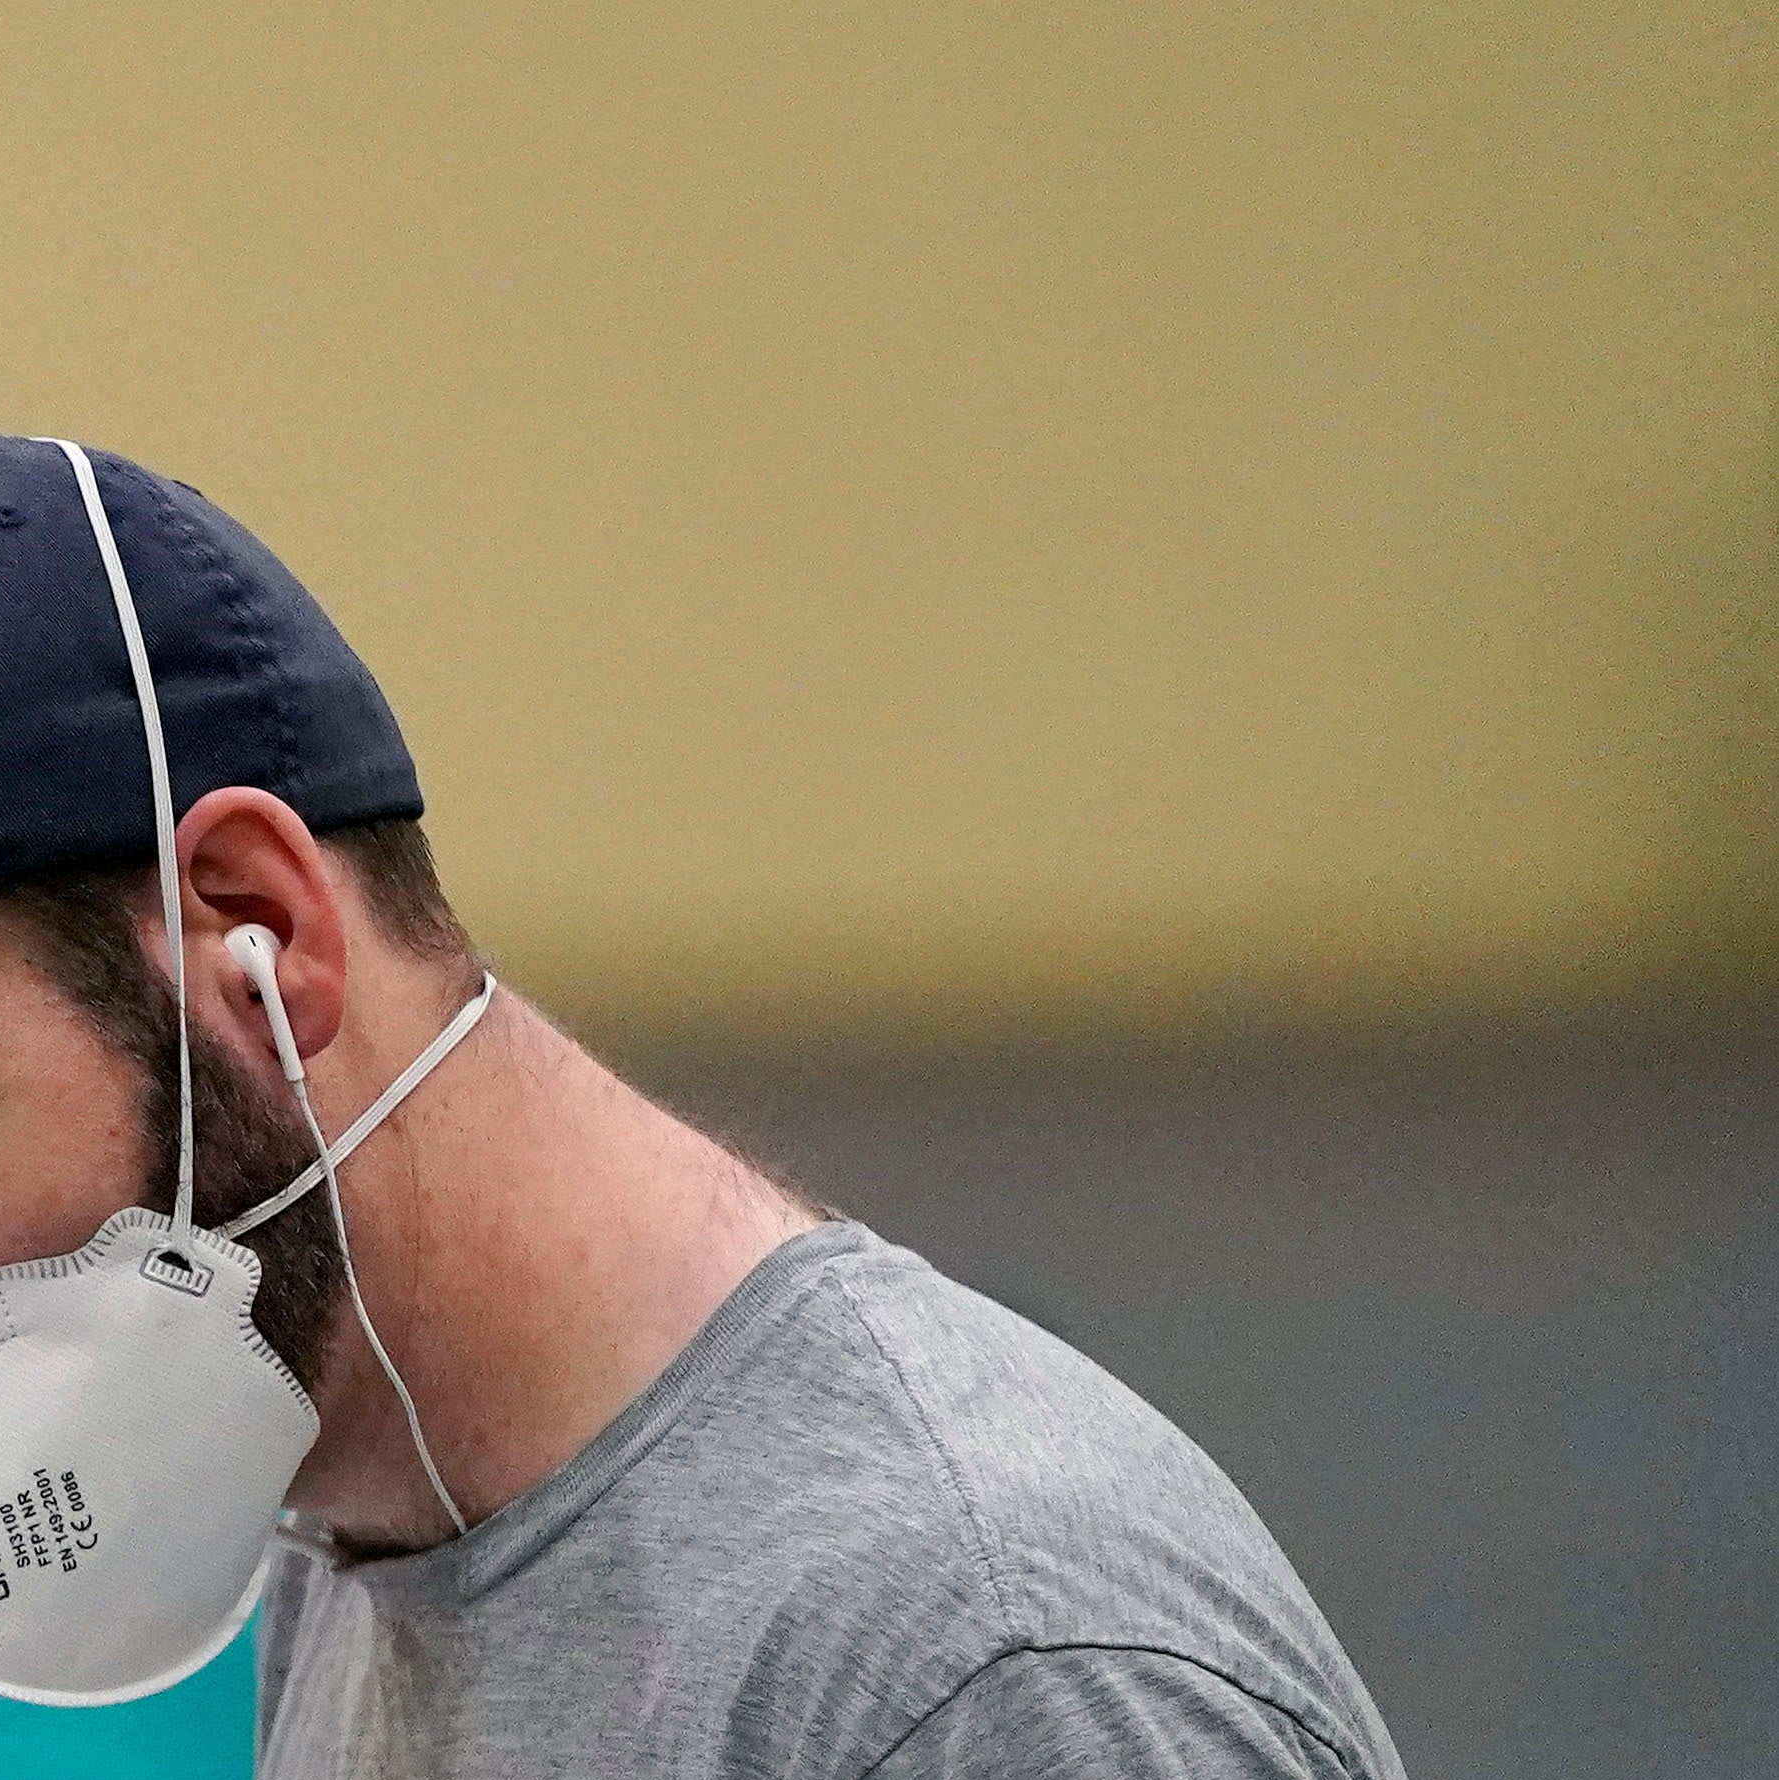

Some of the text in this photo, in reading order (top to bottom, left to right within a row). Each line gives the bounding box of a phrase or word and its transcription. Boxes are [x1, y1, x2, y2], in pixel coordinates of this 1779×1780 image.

[0, 1503, 31, 1569] SH3100
[17, 1489, 53, 1568] FFP1 NR
[33, 1467, 78, 1573] EN 149:2001
[60, 1470, 99, 1550] CE 0086
